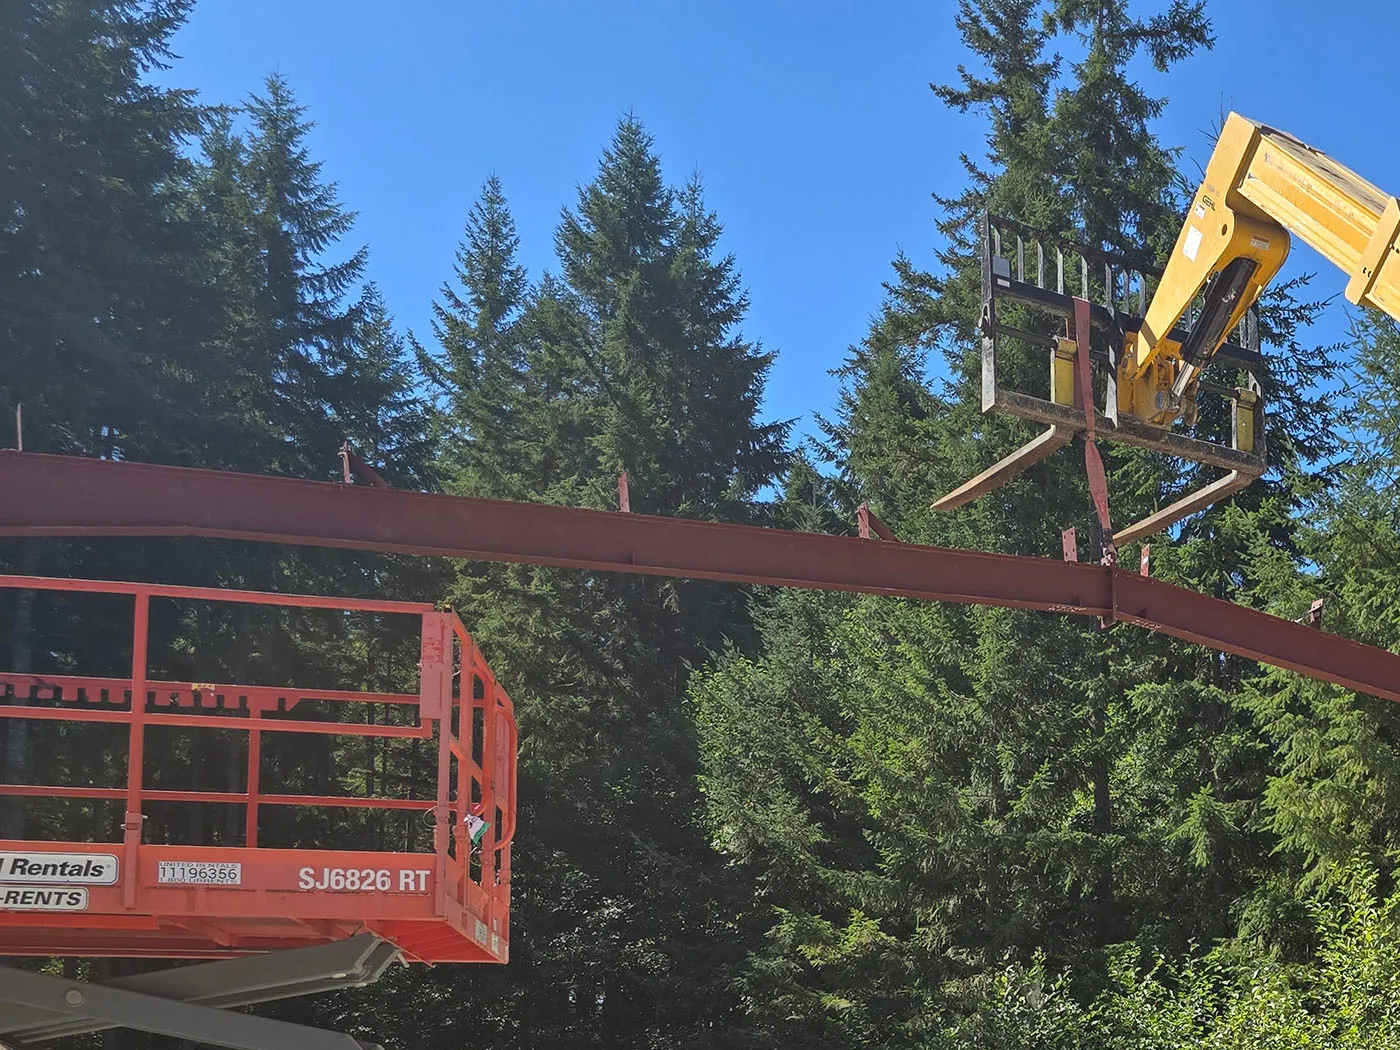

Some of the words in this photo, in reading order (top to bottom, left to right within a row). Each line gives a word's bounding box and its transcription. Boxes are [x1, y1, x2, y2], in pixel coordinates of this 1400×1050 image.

[9, 858, 104, 877] Rentals
[160, 867, 237, 880] 11196356
[298, 867, 392, 891] SJ6826
[399, 869, 431, 891] RT
